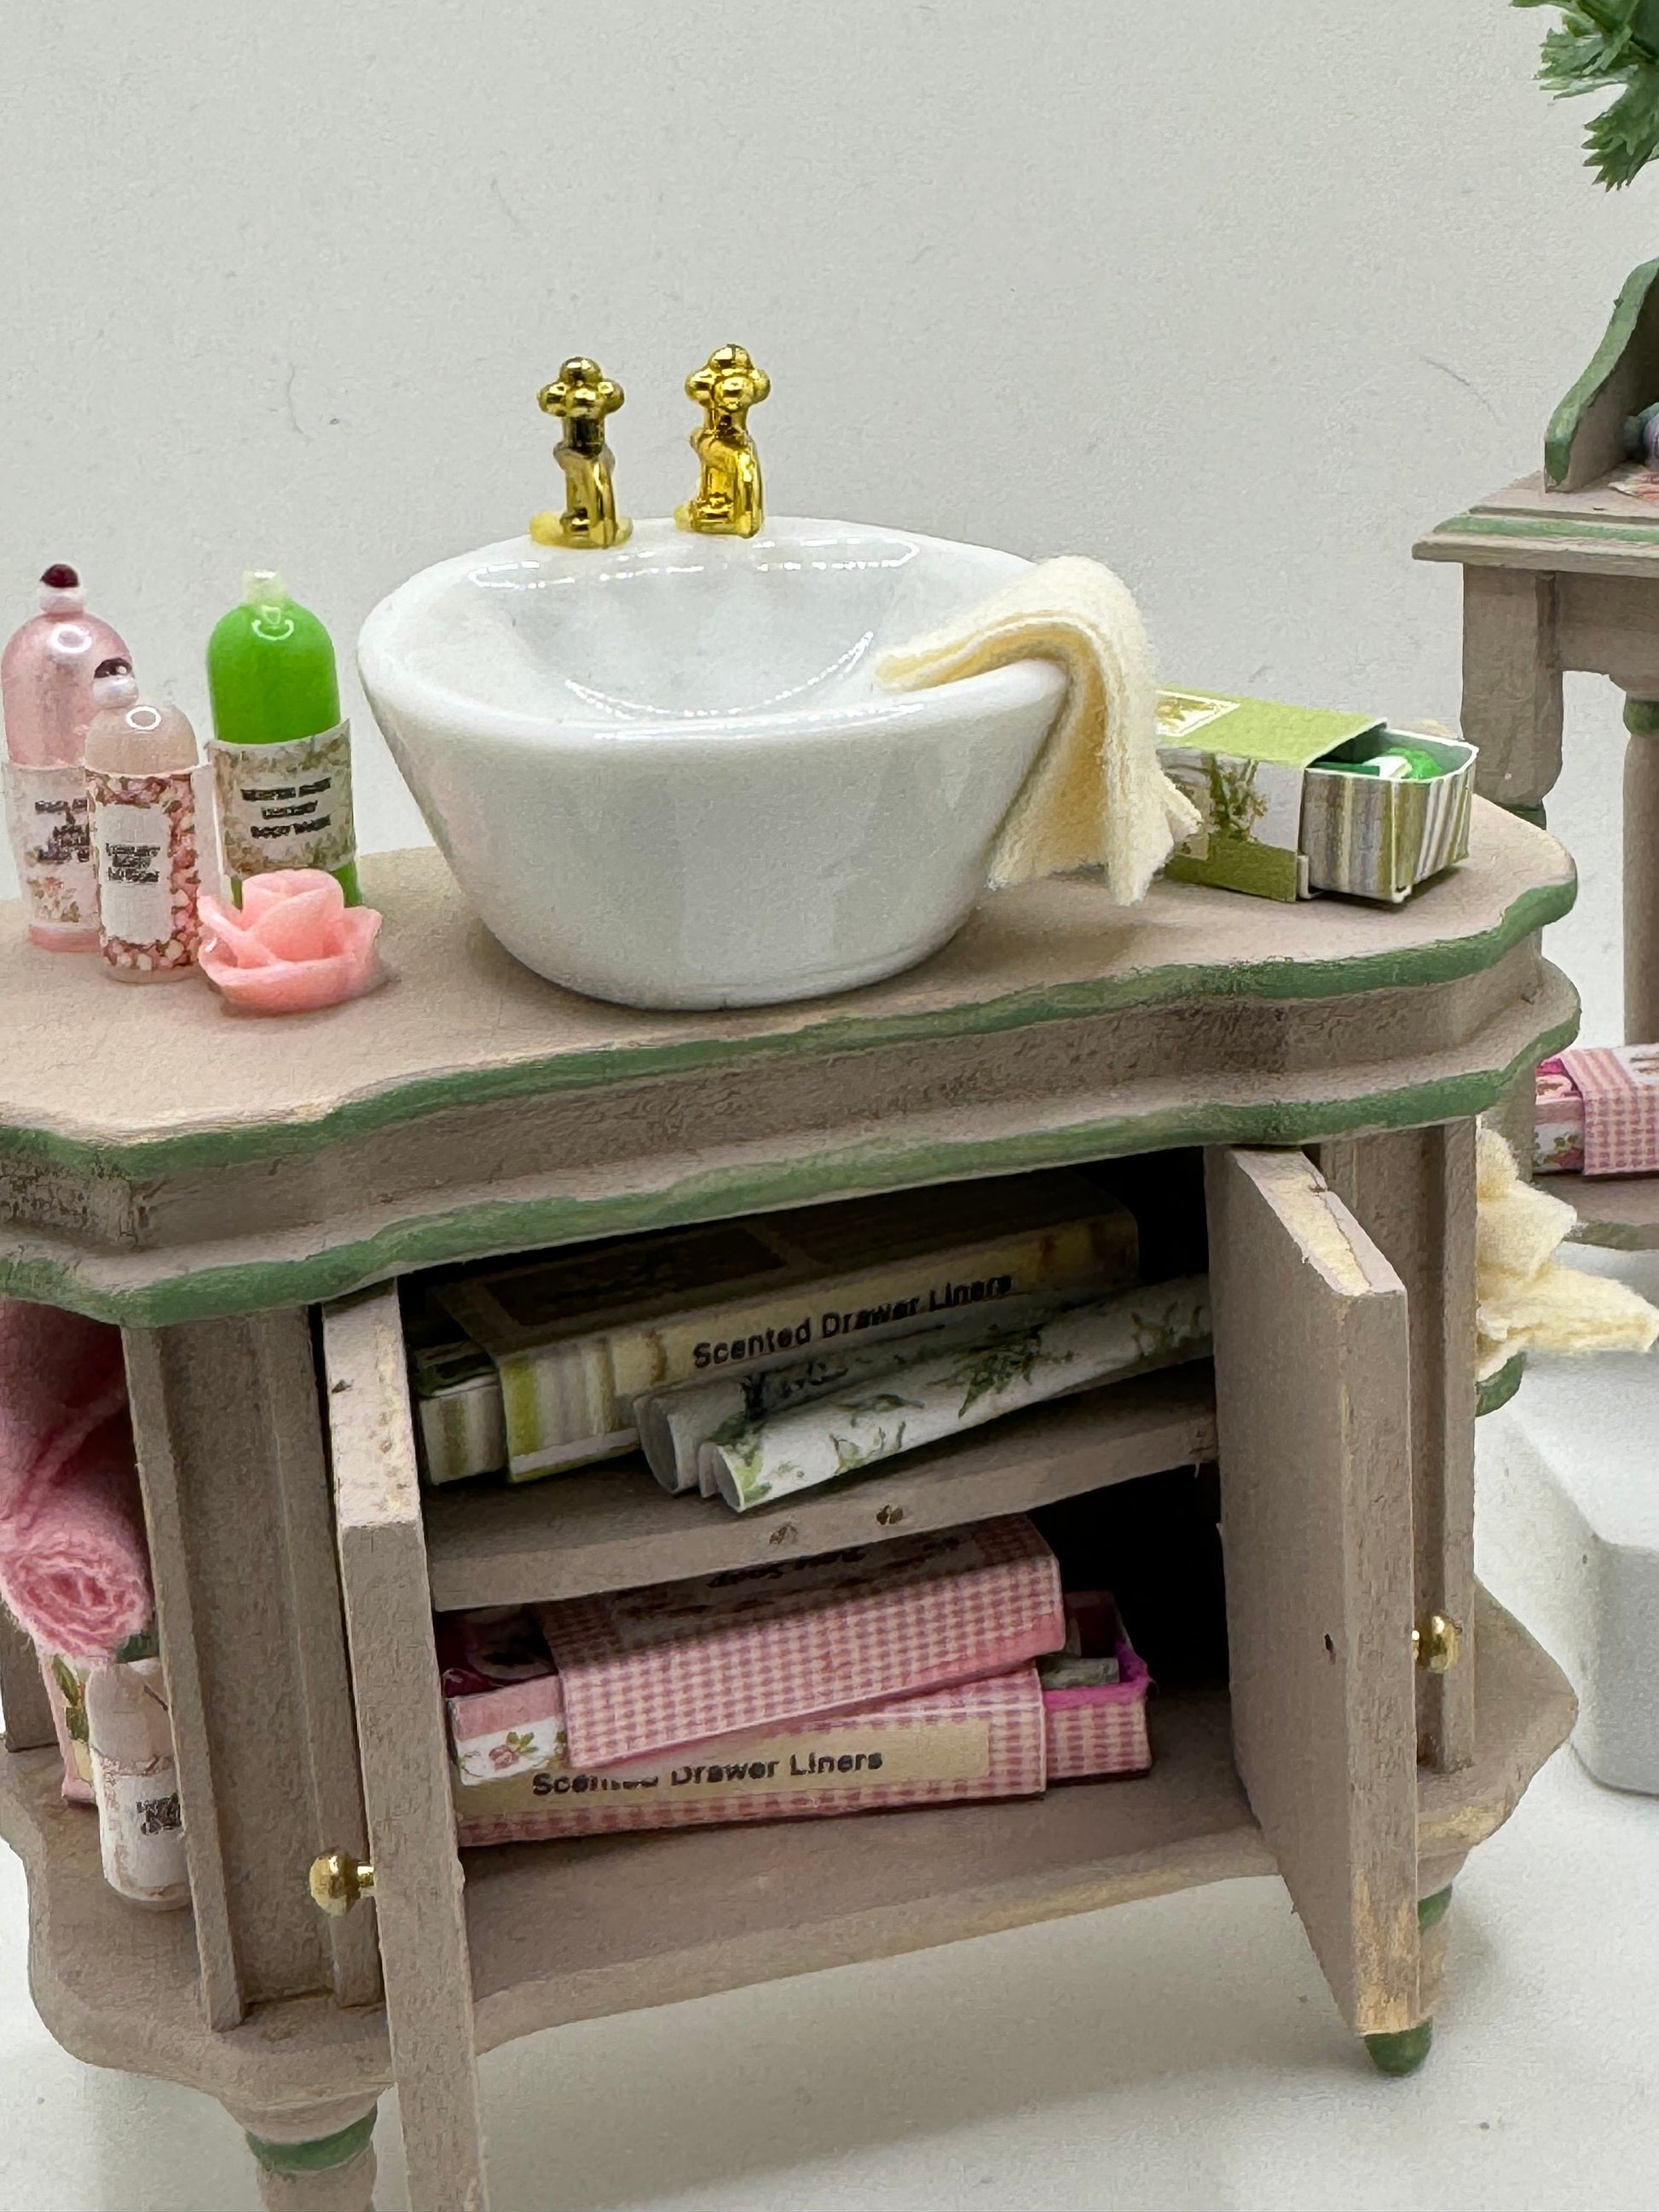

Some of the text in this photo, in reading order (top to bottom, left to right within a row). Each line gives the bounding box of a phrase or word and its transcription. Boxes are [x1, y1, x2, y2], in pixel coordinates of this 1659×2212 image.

[693, 1276, 1013, 1367] Scented Drawer Liners
[670, 1759, 779, 1786] Drawer
[790, 1751, 883, 1776] Liners
